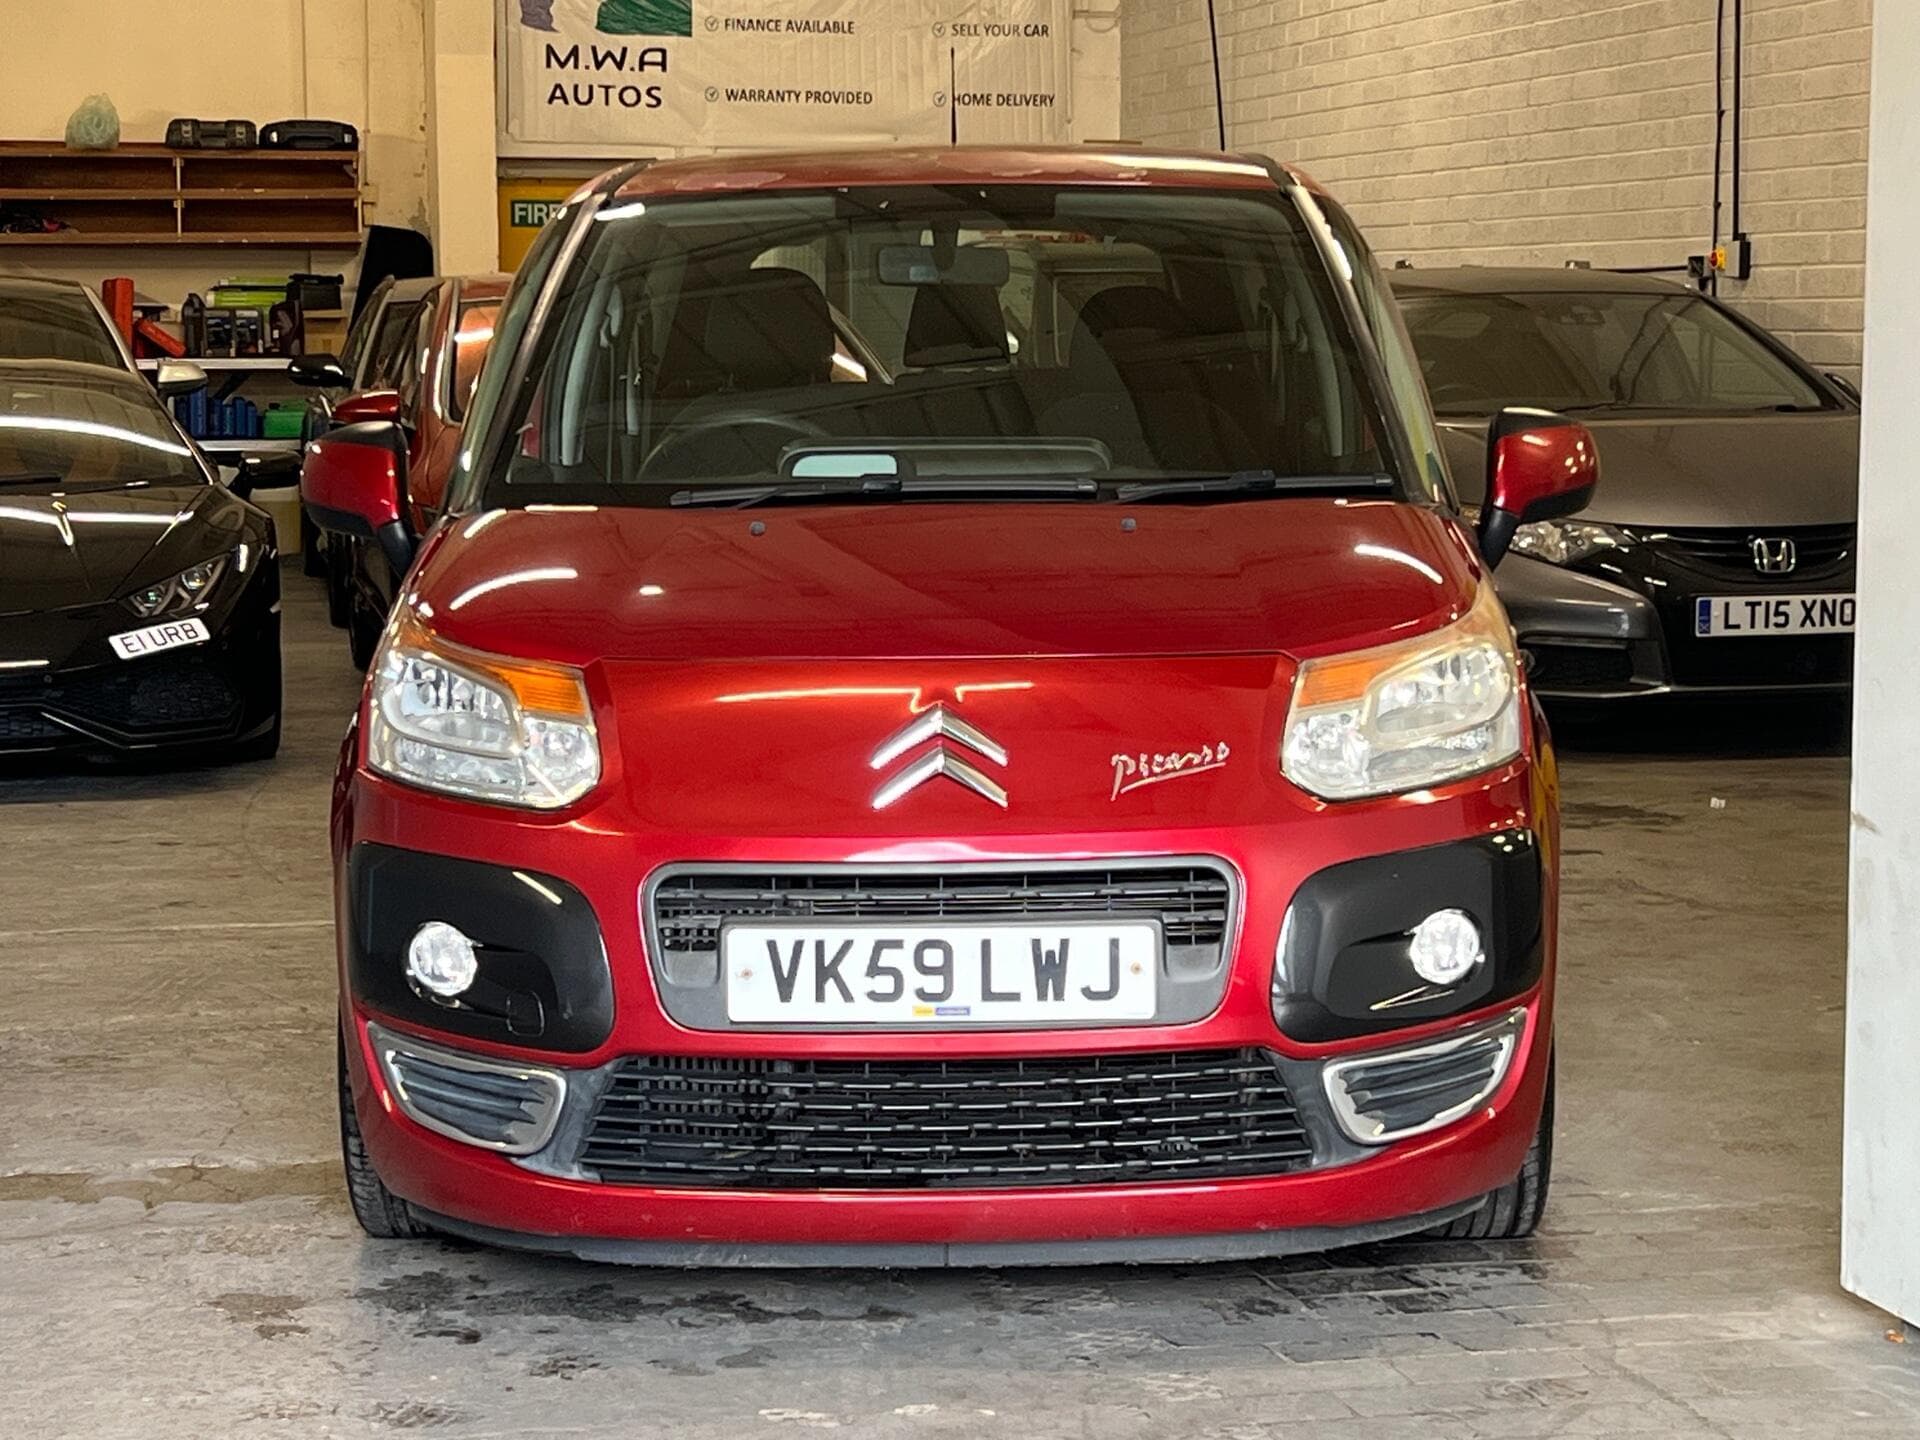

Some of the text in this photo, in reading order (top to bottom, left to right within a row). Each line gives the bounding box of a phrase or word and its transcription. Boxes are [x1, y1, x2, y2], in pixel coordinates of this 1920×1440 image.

[724, 18, 855, 34] FINANCE AVAILABLE
[951, 23, 1049, 38] SELL YOUR CAR
[545, 43, 667, 73] M.W.A
[547, 83, 662, 108] AUTOS
[725, 88, 873, 104] WARRANTY PROVIDED
[996, 93, 1055, 108] DELIVERY
[766, 938, 1120, 1002] VK59 LWJ
